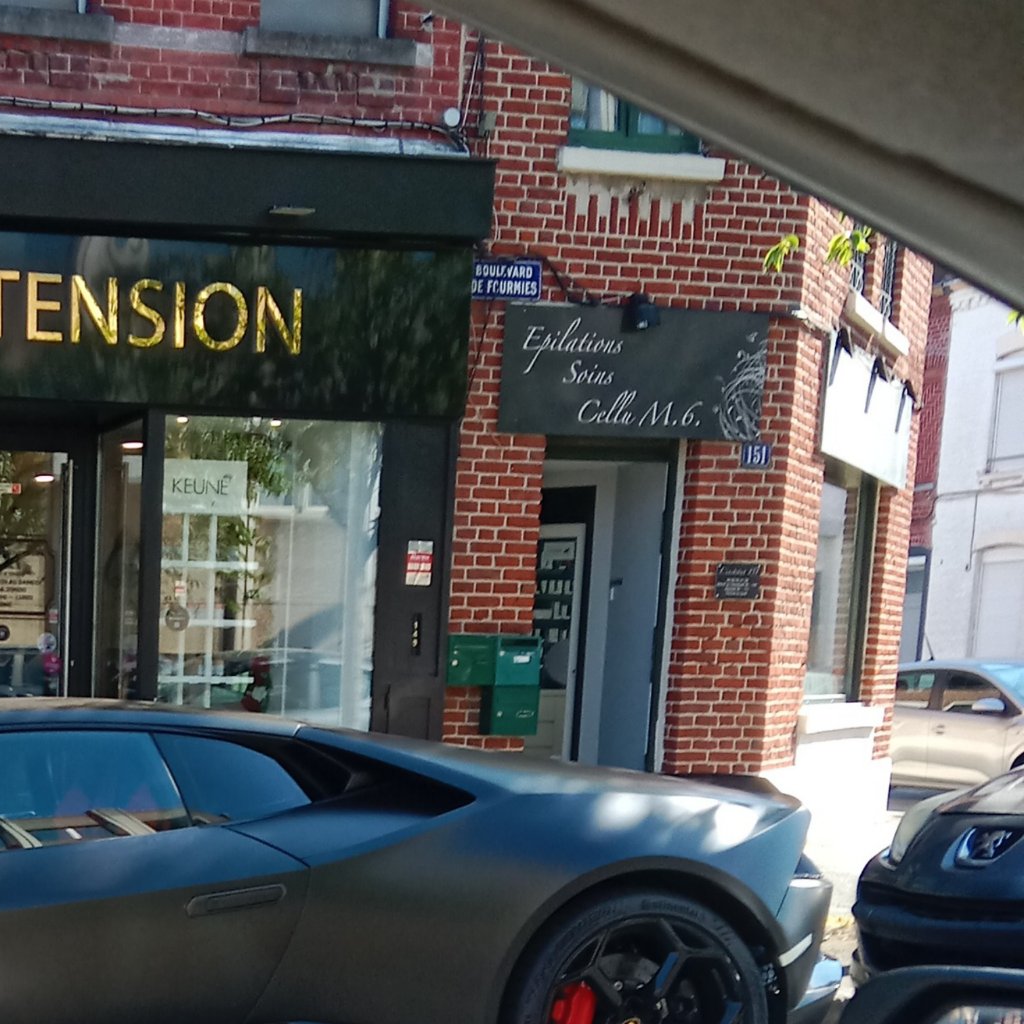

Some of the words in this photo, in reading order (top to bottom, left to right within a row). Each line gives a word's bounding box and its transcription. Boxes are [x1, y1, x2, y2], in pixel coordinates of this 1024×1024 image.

[471, 279, 484, 294] DE
[522, 316, 624, 374] Epilations
[561, 360, 615, 386] Soins
[577, 389, 638, 427] Cellu
[745, 445, 767, 464] 151
[171, 477, 230, 496] KEUNE
